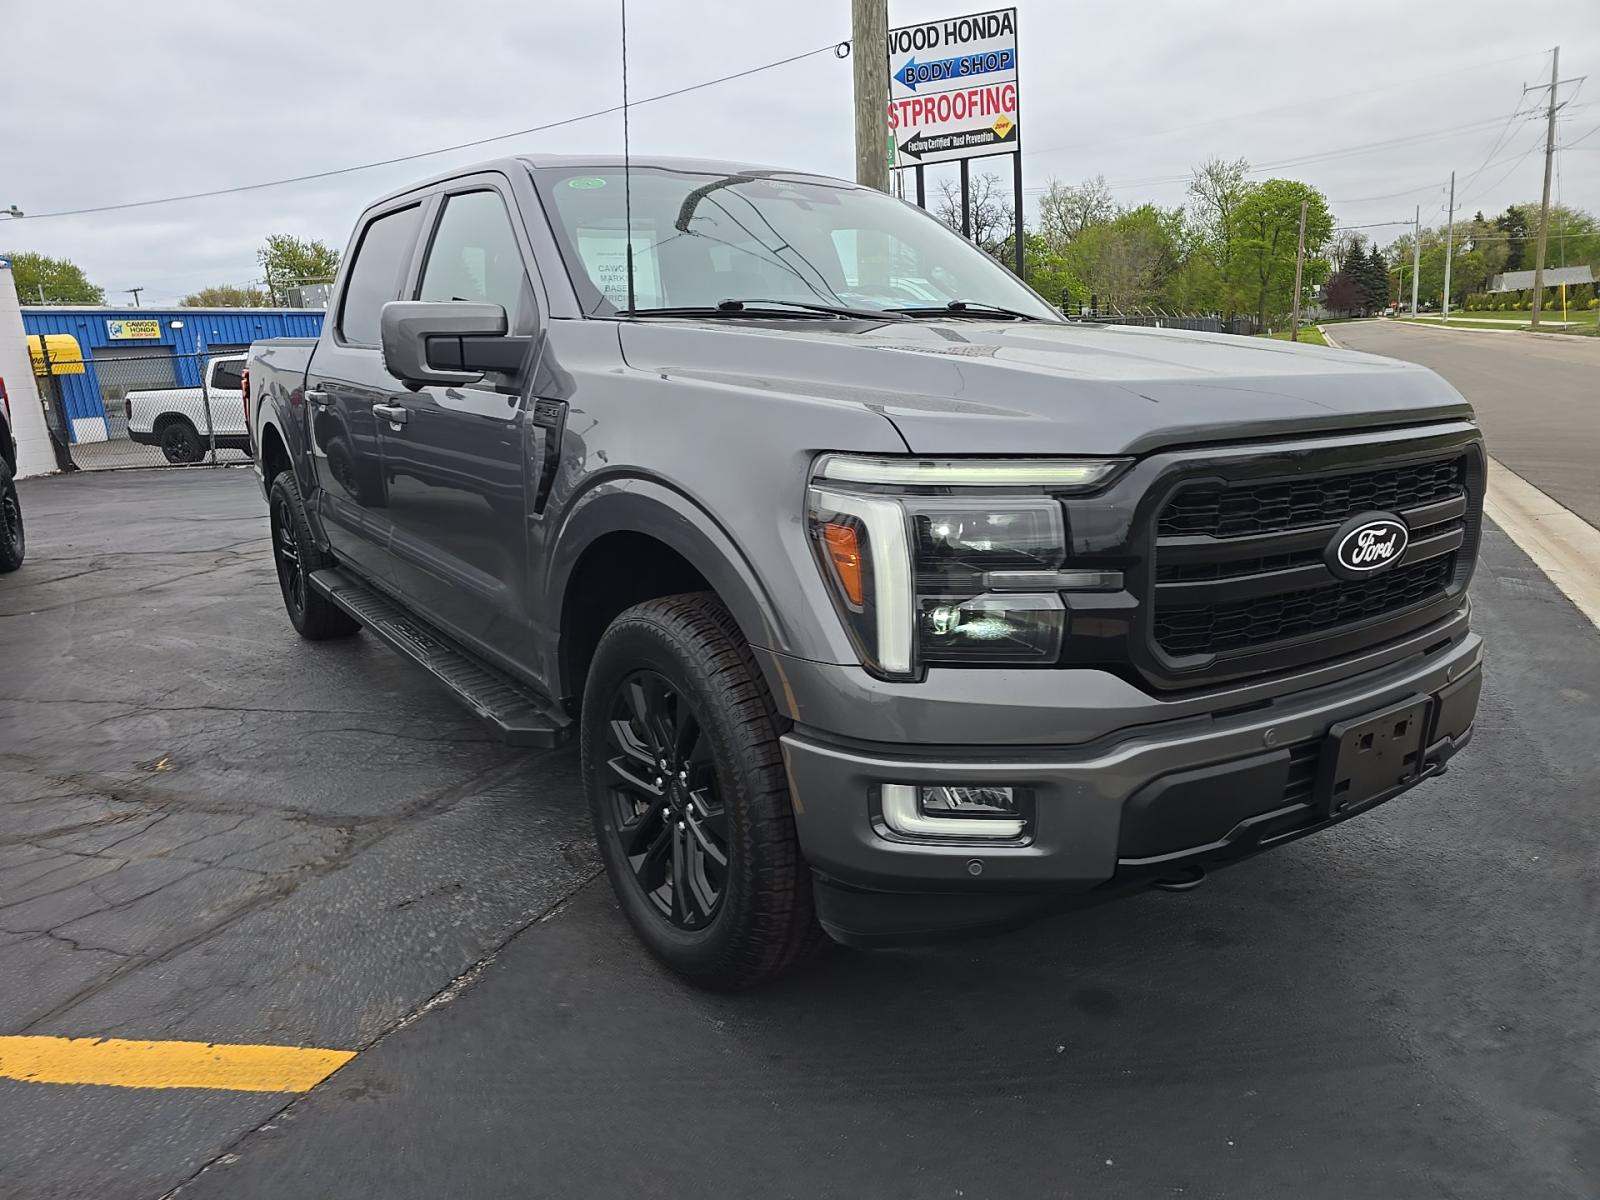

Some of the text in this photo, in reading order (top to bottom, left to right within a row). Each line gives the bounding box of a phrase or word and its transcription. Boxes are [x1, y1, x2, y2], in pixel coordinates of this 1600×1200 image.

[943, 12, 1014, 46] HONDA
[905, 51, 1010, 84] BODY SHOP
[907, 141, 928, 152] Factory
[952, 136, 966, 147] Rust
[965, 132, 994, 145] Prevention
[598, 264, 638, 273] CAWOD
[1352, 528, 1397, 564] Ford
